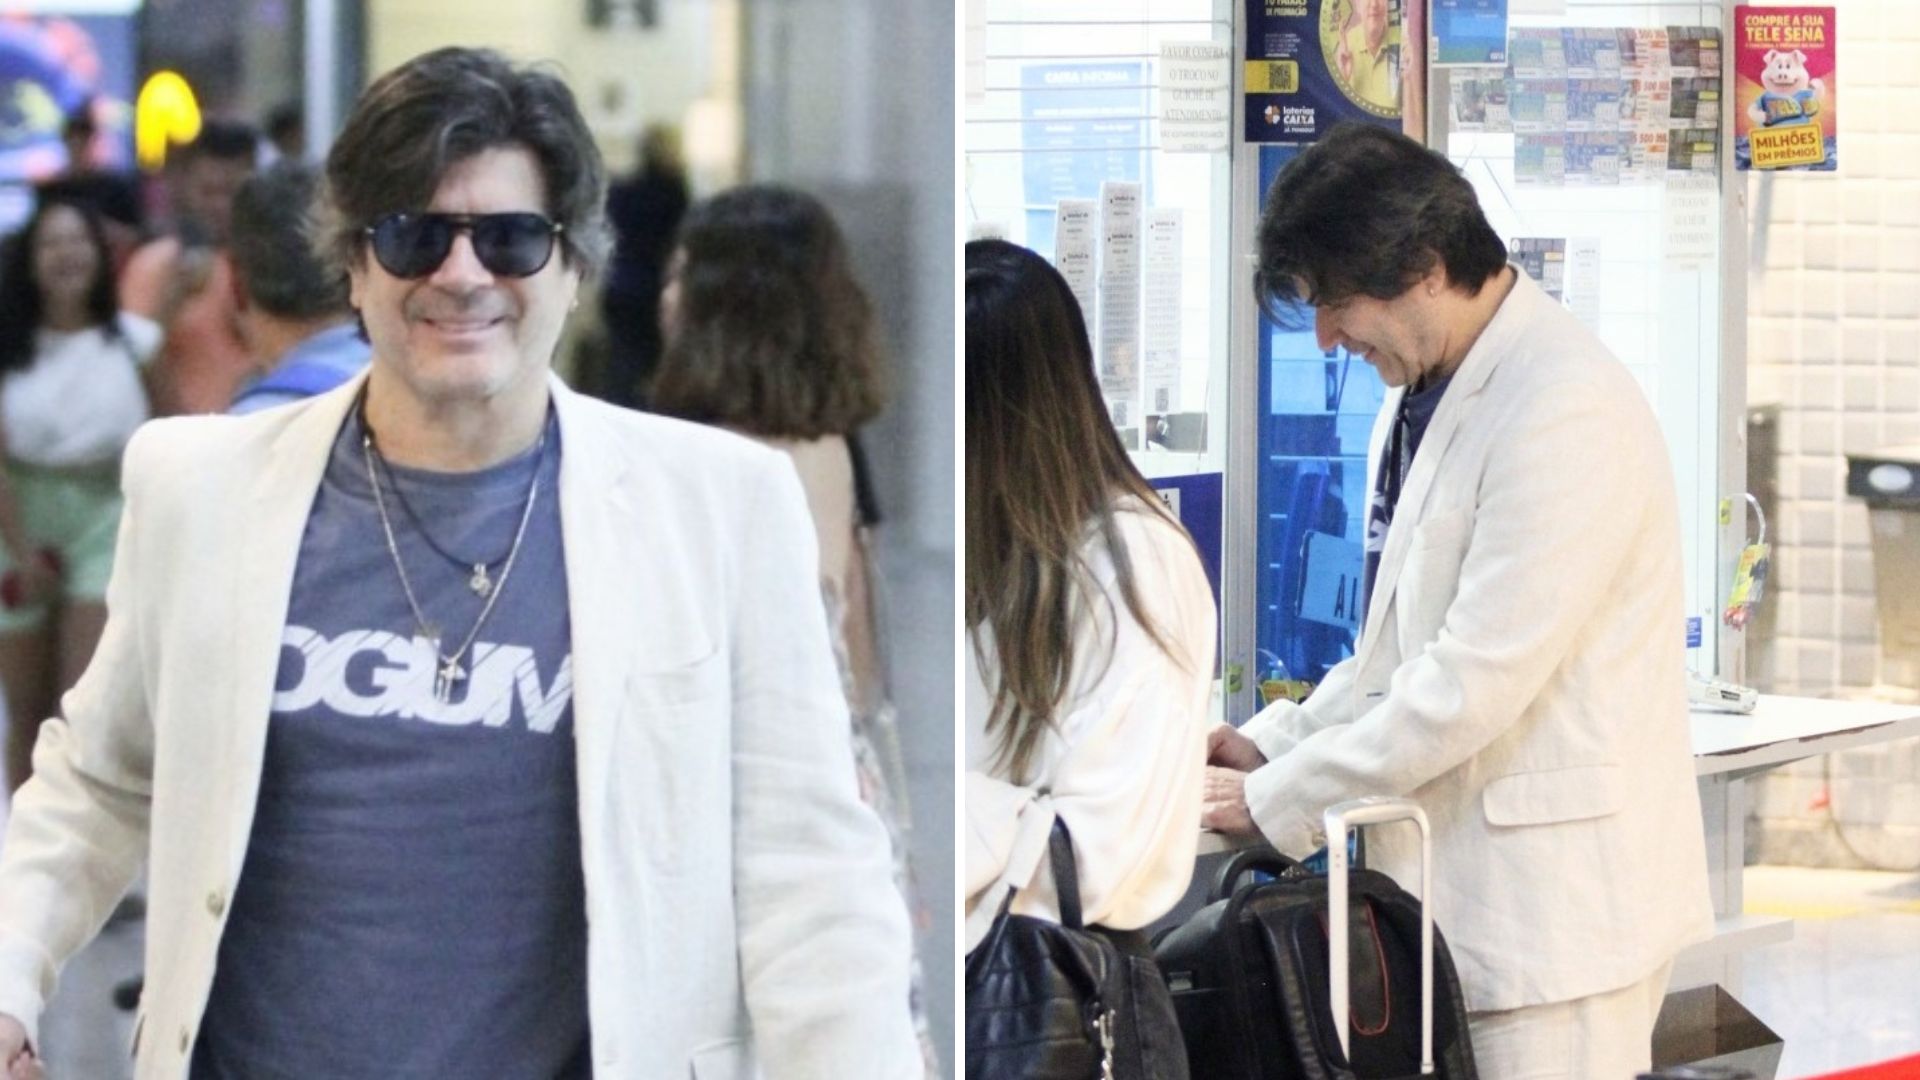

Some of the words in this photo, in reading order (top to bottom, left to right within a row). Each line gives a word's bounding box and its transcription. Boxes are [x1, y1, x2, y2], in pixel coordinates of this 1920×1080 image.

[1745, 14, 1790, 26] COMPRE
[1792, 14, 1801, 26] A
[1802, 14, 1825, 26] SUA
[1745, 26, 1780, 42] TELE
[1783, 26, 1825, 42] SENA
[1283, 105, 1315, 115] loterias
[1283, 115, 1315, 125] CAIXA
[1756, 130, 1816, 149] MILHÕES
[1757, 151, 1772, 162] EM
[1774, 147, 1817, 159] PRÊMIOS
